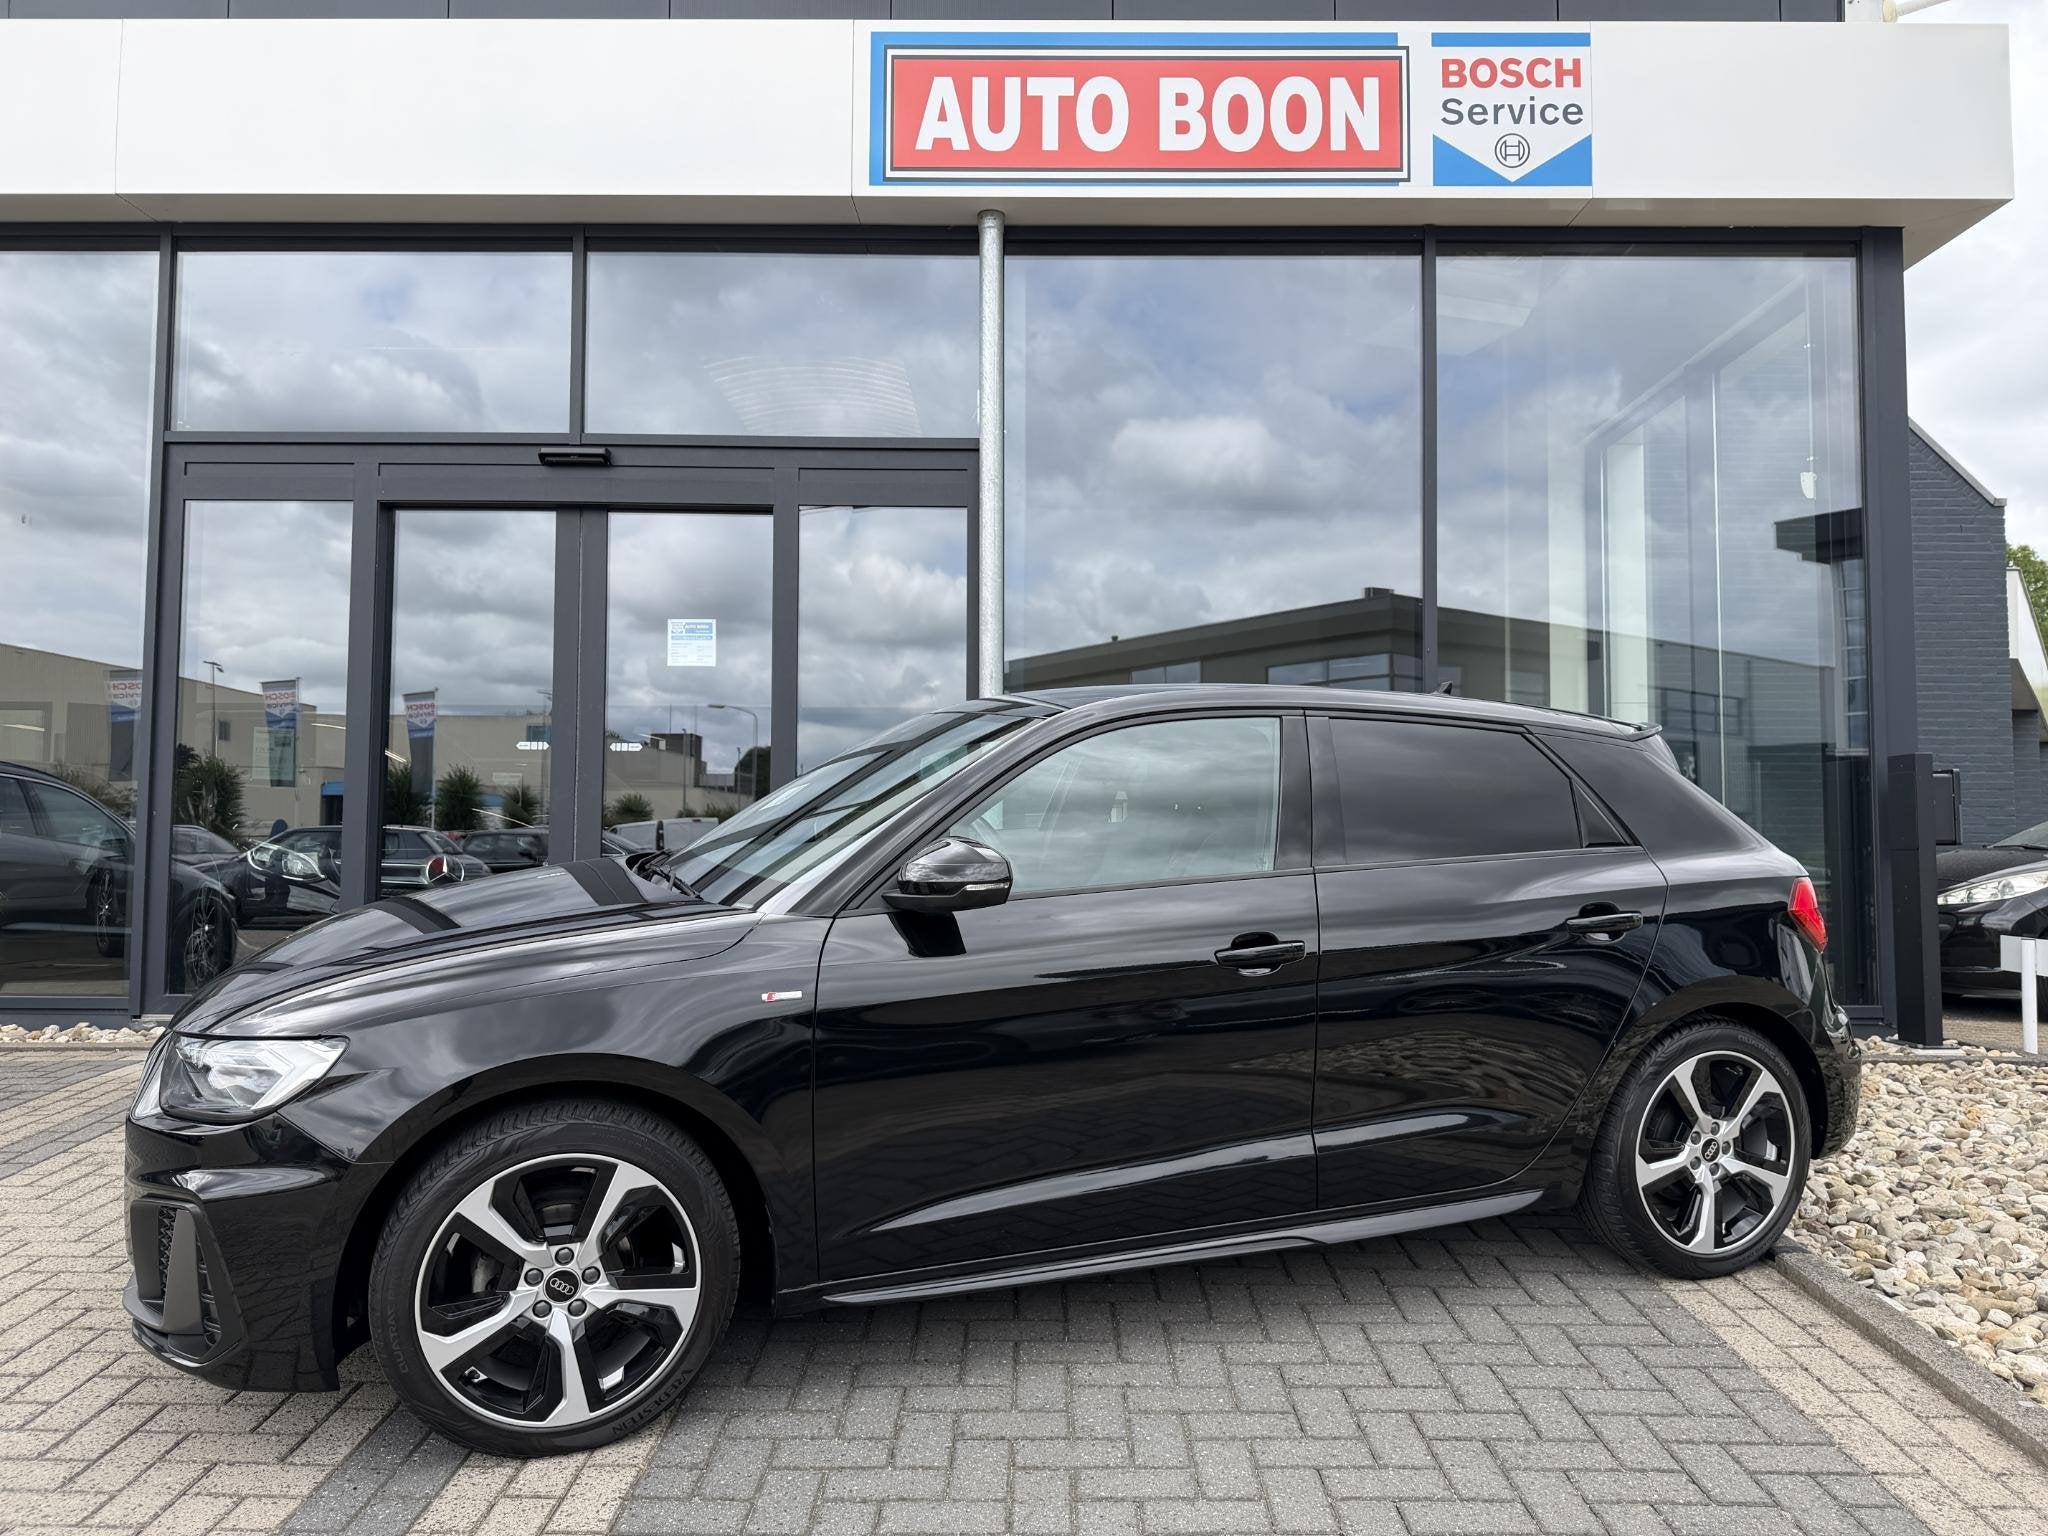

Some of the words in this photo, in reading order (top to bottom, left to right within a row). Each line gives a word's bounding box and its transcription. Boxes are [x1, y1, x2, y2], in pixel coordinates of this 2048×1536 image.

[1441, 57, 1583, 89] BOSCH
[914, 75, 1130, 153] AUTO
[1158, 75, 1381, 154] BOON
[1440, 96, 1585, 126] Service
[387, 1303, 409, 1374] QUATRAC
[611, 1368, 695, 1435] VREDESTEIN
